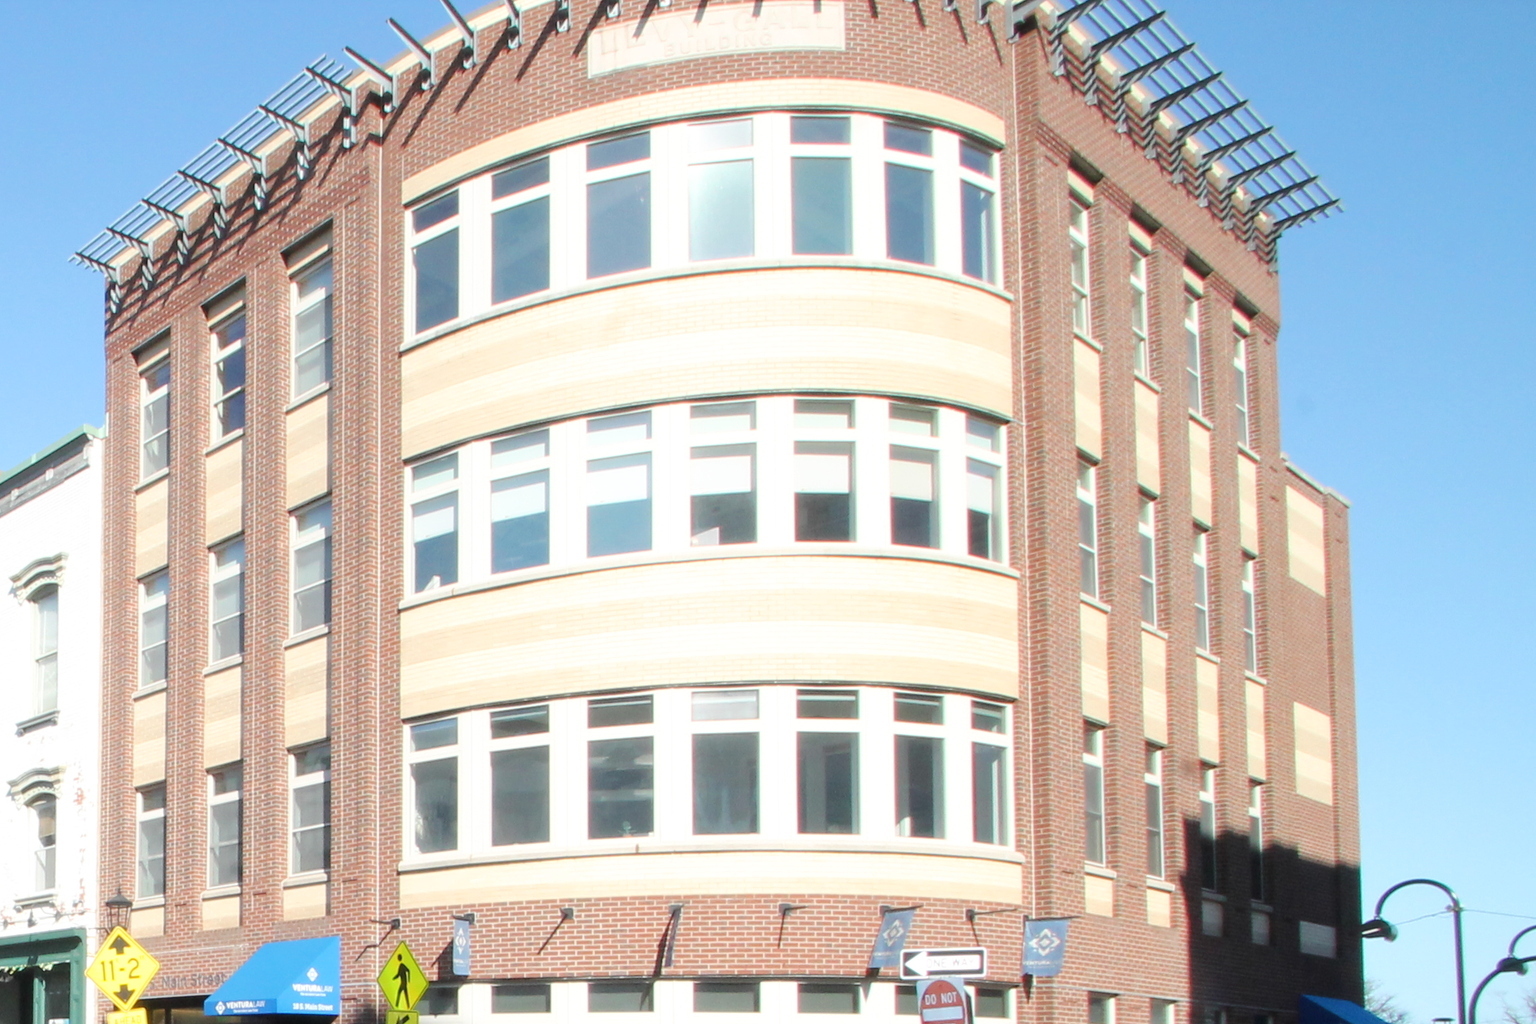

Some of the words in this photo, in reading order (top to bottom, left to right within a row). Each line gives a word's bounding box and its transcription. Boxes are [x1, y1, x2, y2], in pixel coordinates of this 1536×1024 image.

[663, 32, 774, 57] BUILDING
[927, 958, 947, 969] ONE
[952, 957, 975, 967] WAY
[925, 994, 936, 1005] DO
[941, 992, 957, 1003] NOT
